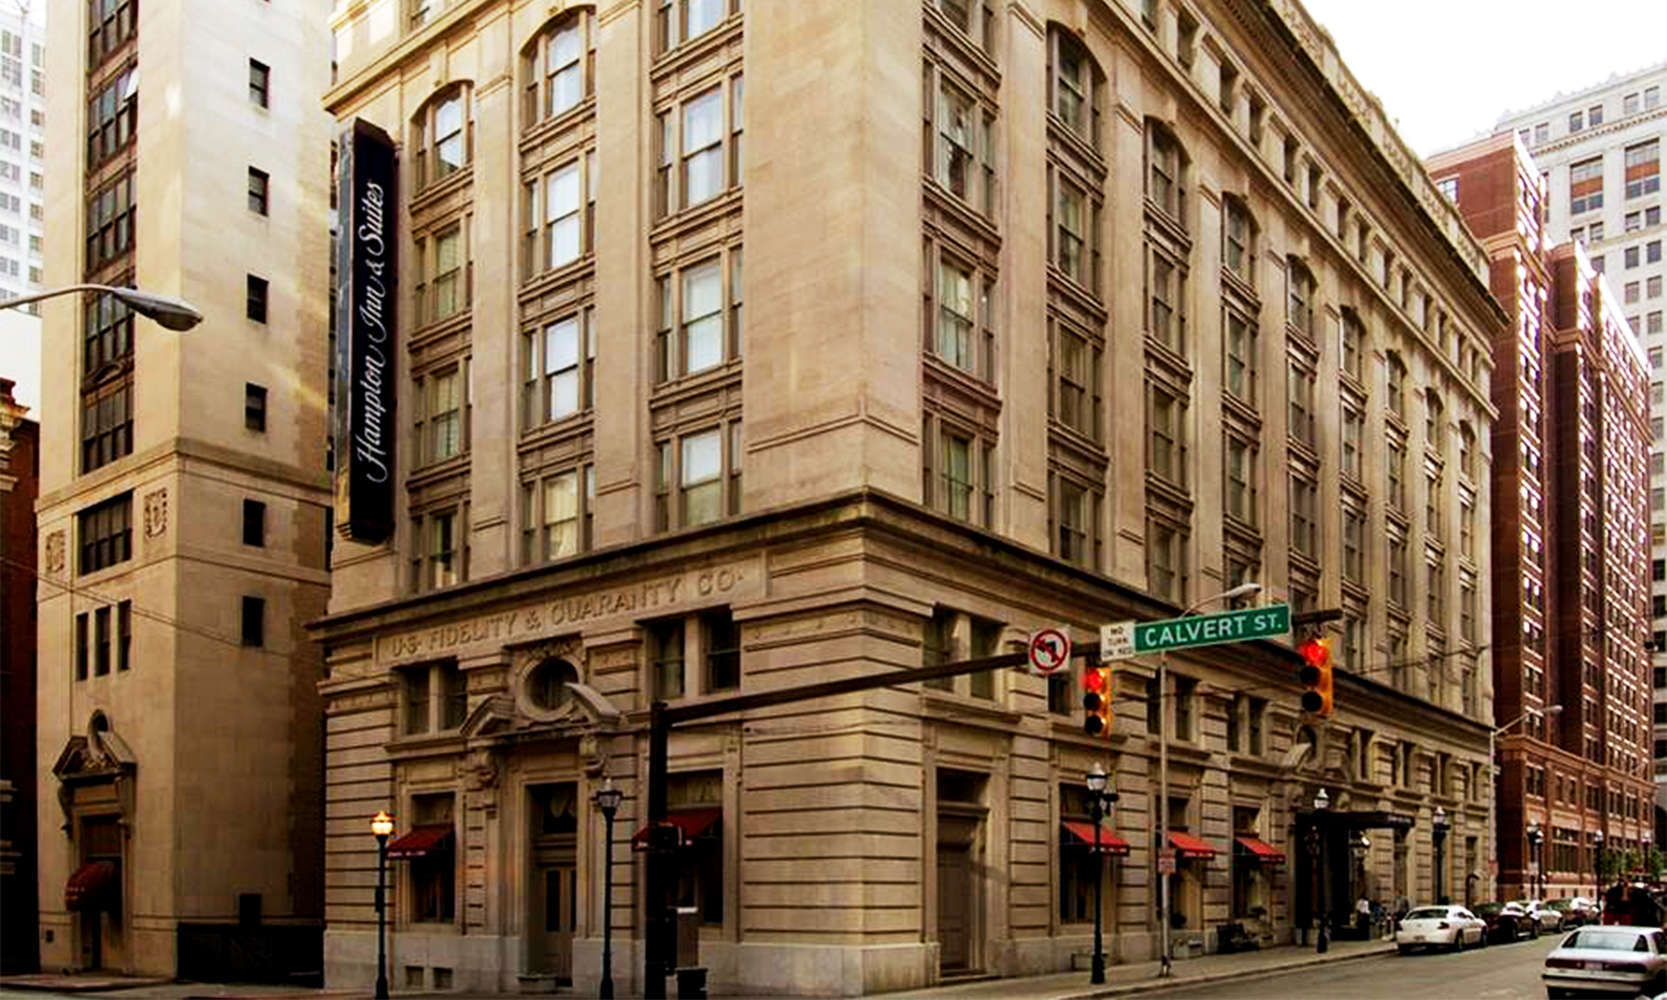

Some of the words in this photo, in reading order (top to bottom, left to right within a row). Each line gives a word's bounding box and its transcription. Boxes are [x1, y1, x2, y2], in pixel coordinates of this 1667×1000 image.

[358, 180, 384, 256] Suites
[365, 258, 385, 277] &
[359, 275, 387, 342] Inn
[355, 344, 388, 483] Hampton
[429, 612, 517, 650] FIDELITY
[525, 609, 542, 631] &
[1110, 625, 1124, 635] NO
[1145, 615, 1247, 647] CALVERT
[1254, 613, 1283, 631] ST.
